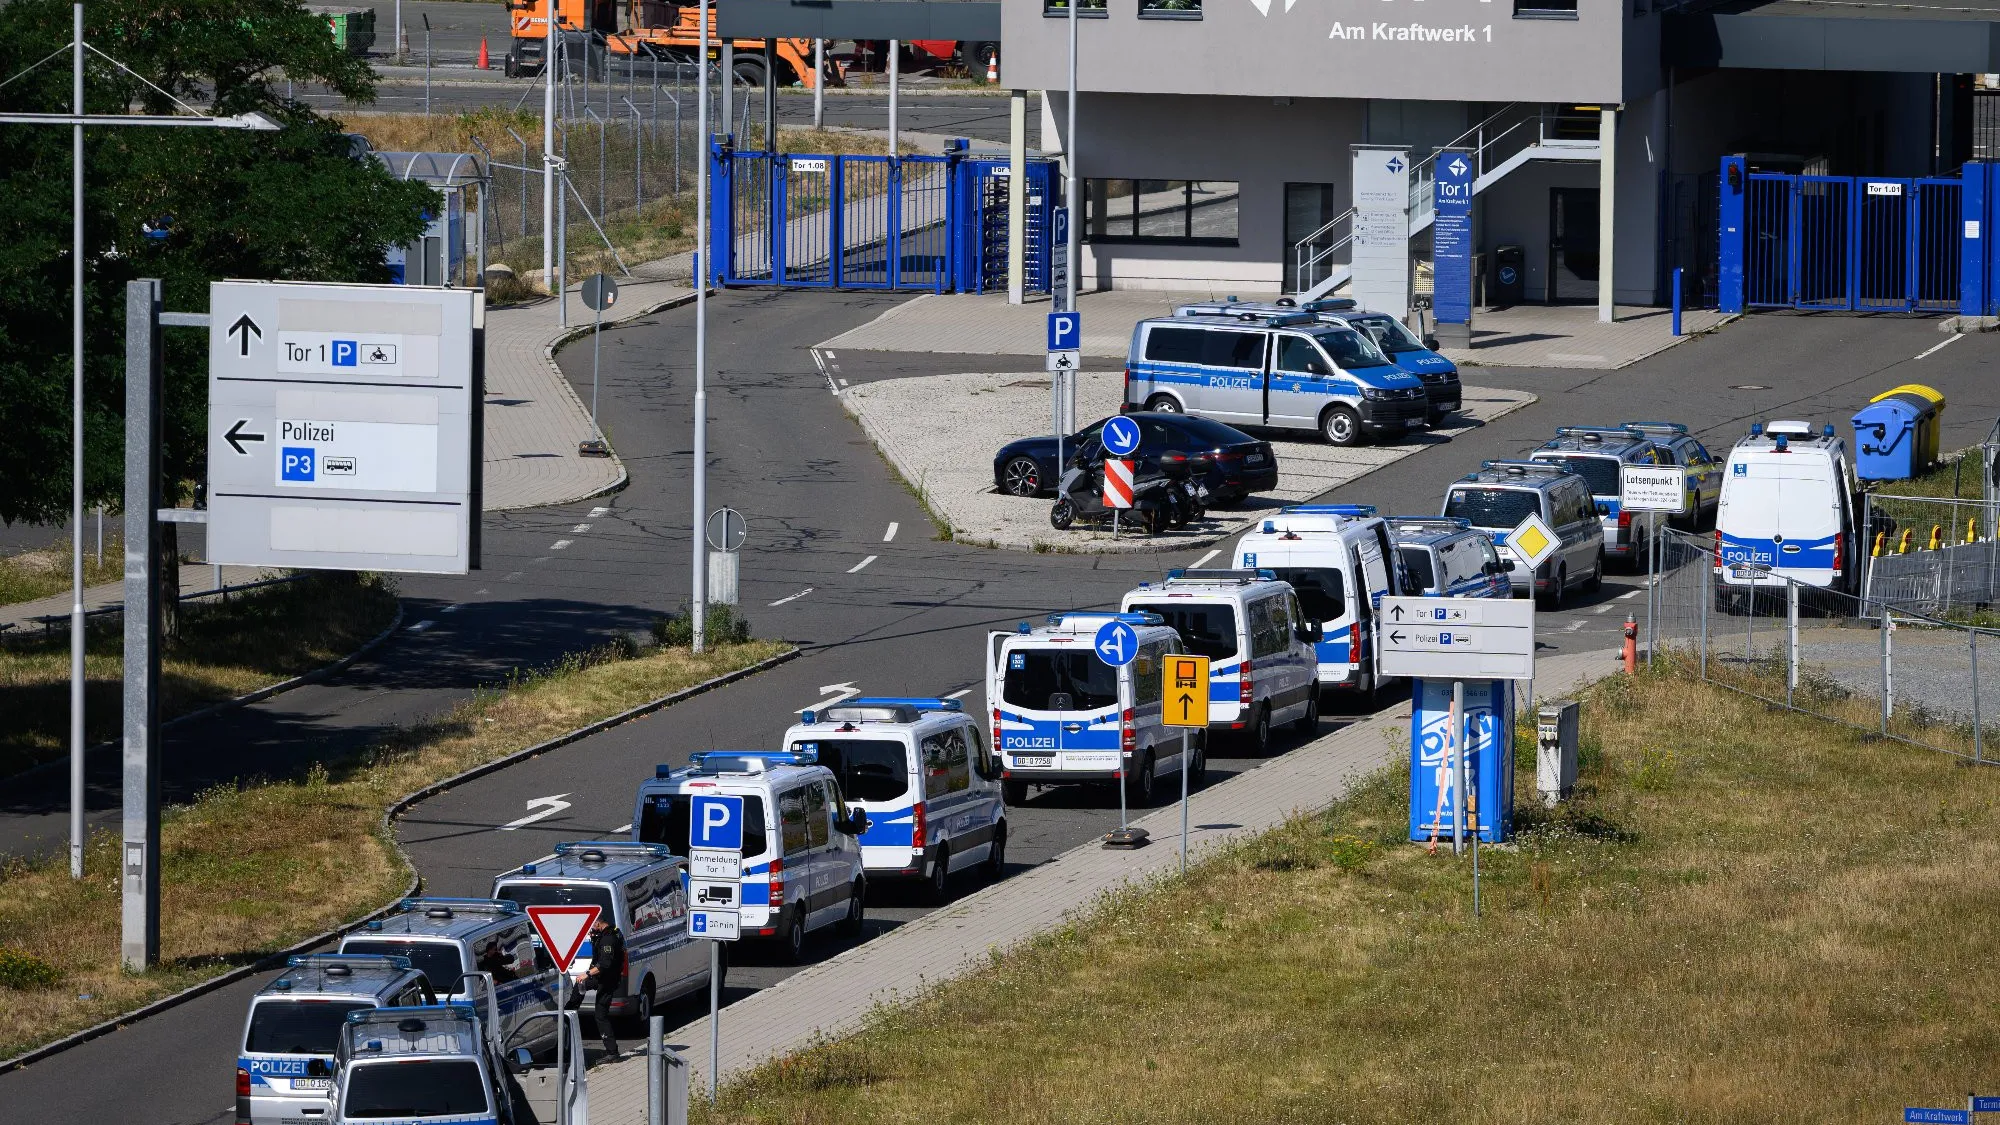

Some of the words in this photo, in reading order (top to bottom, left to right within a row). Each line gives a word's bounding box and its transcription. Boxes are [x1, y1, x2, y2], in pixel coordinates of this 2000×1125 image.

[1328, 21, 1366, 40] Am
[1372, 22, 1476, 42] Kraftwerk
[1482, 24, 1492, 43] 1
[808, 162, 825, 170] 1.08
[1438, 181, 1461, 196] Tor
[1463, 182, 1469, 196] 1
[1869, 185, 1882, 193] Tor
[1884, 185, 1901, 193] 1.01
[1057, 213, 1066, 241] P
[1055, 317, 1073, 345] P
[285, 342, 311, 362] Tor
[319, 344, 325, 362] 1
[337, 343, 352, 364] P
[1209, 377, 1251, 388] POLIZEI
[282, 421, 334, 442] Polizei
[285, 455, 311, 474] P3
[1626, 475, 1673, 487] Lotsenpunkt
[1676, 477, 1680, 486] 1
[1416, 609, 1428, 618] Tor
[1415, 634, 1438, 643] Polizei
[1006, 737, 1055, 748] POLIZEI
[702, 803, 731, 841] P
[693, 855, 738, 866] Anmeldung
[250, 1060, 305, 1074] POLIZEI
[1909, 1110, 1923, 1120] Am
[1925, 1112, 1963, 1122] Kraftwerk
